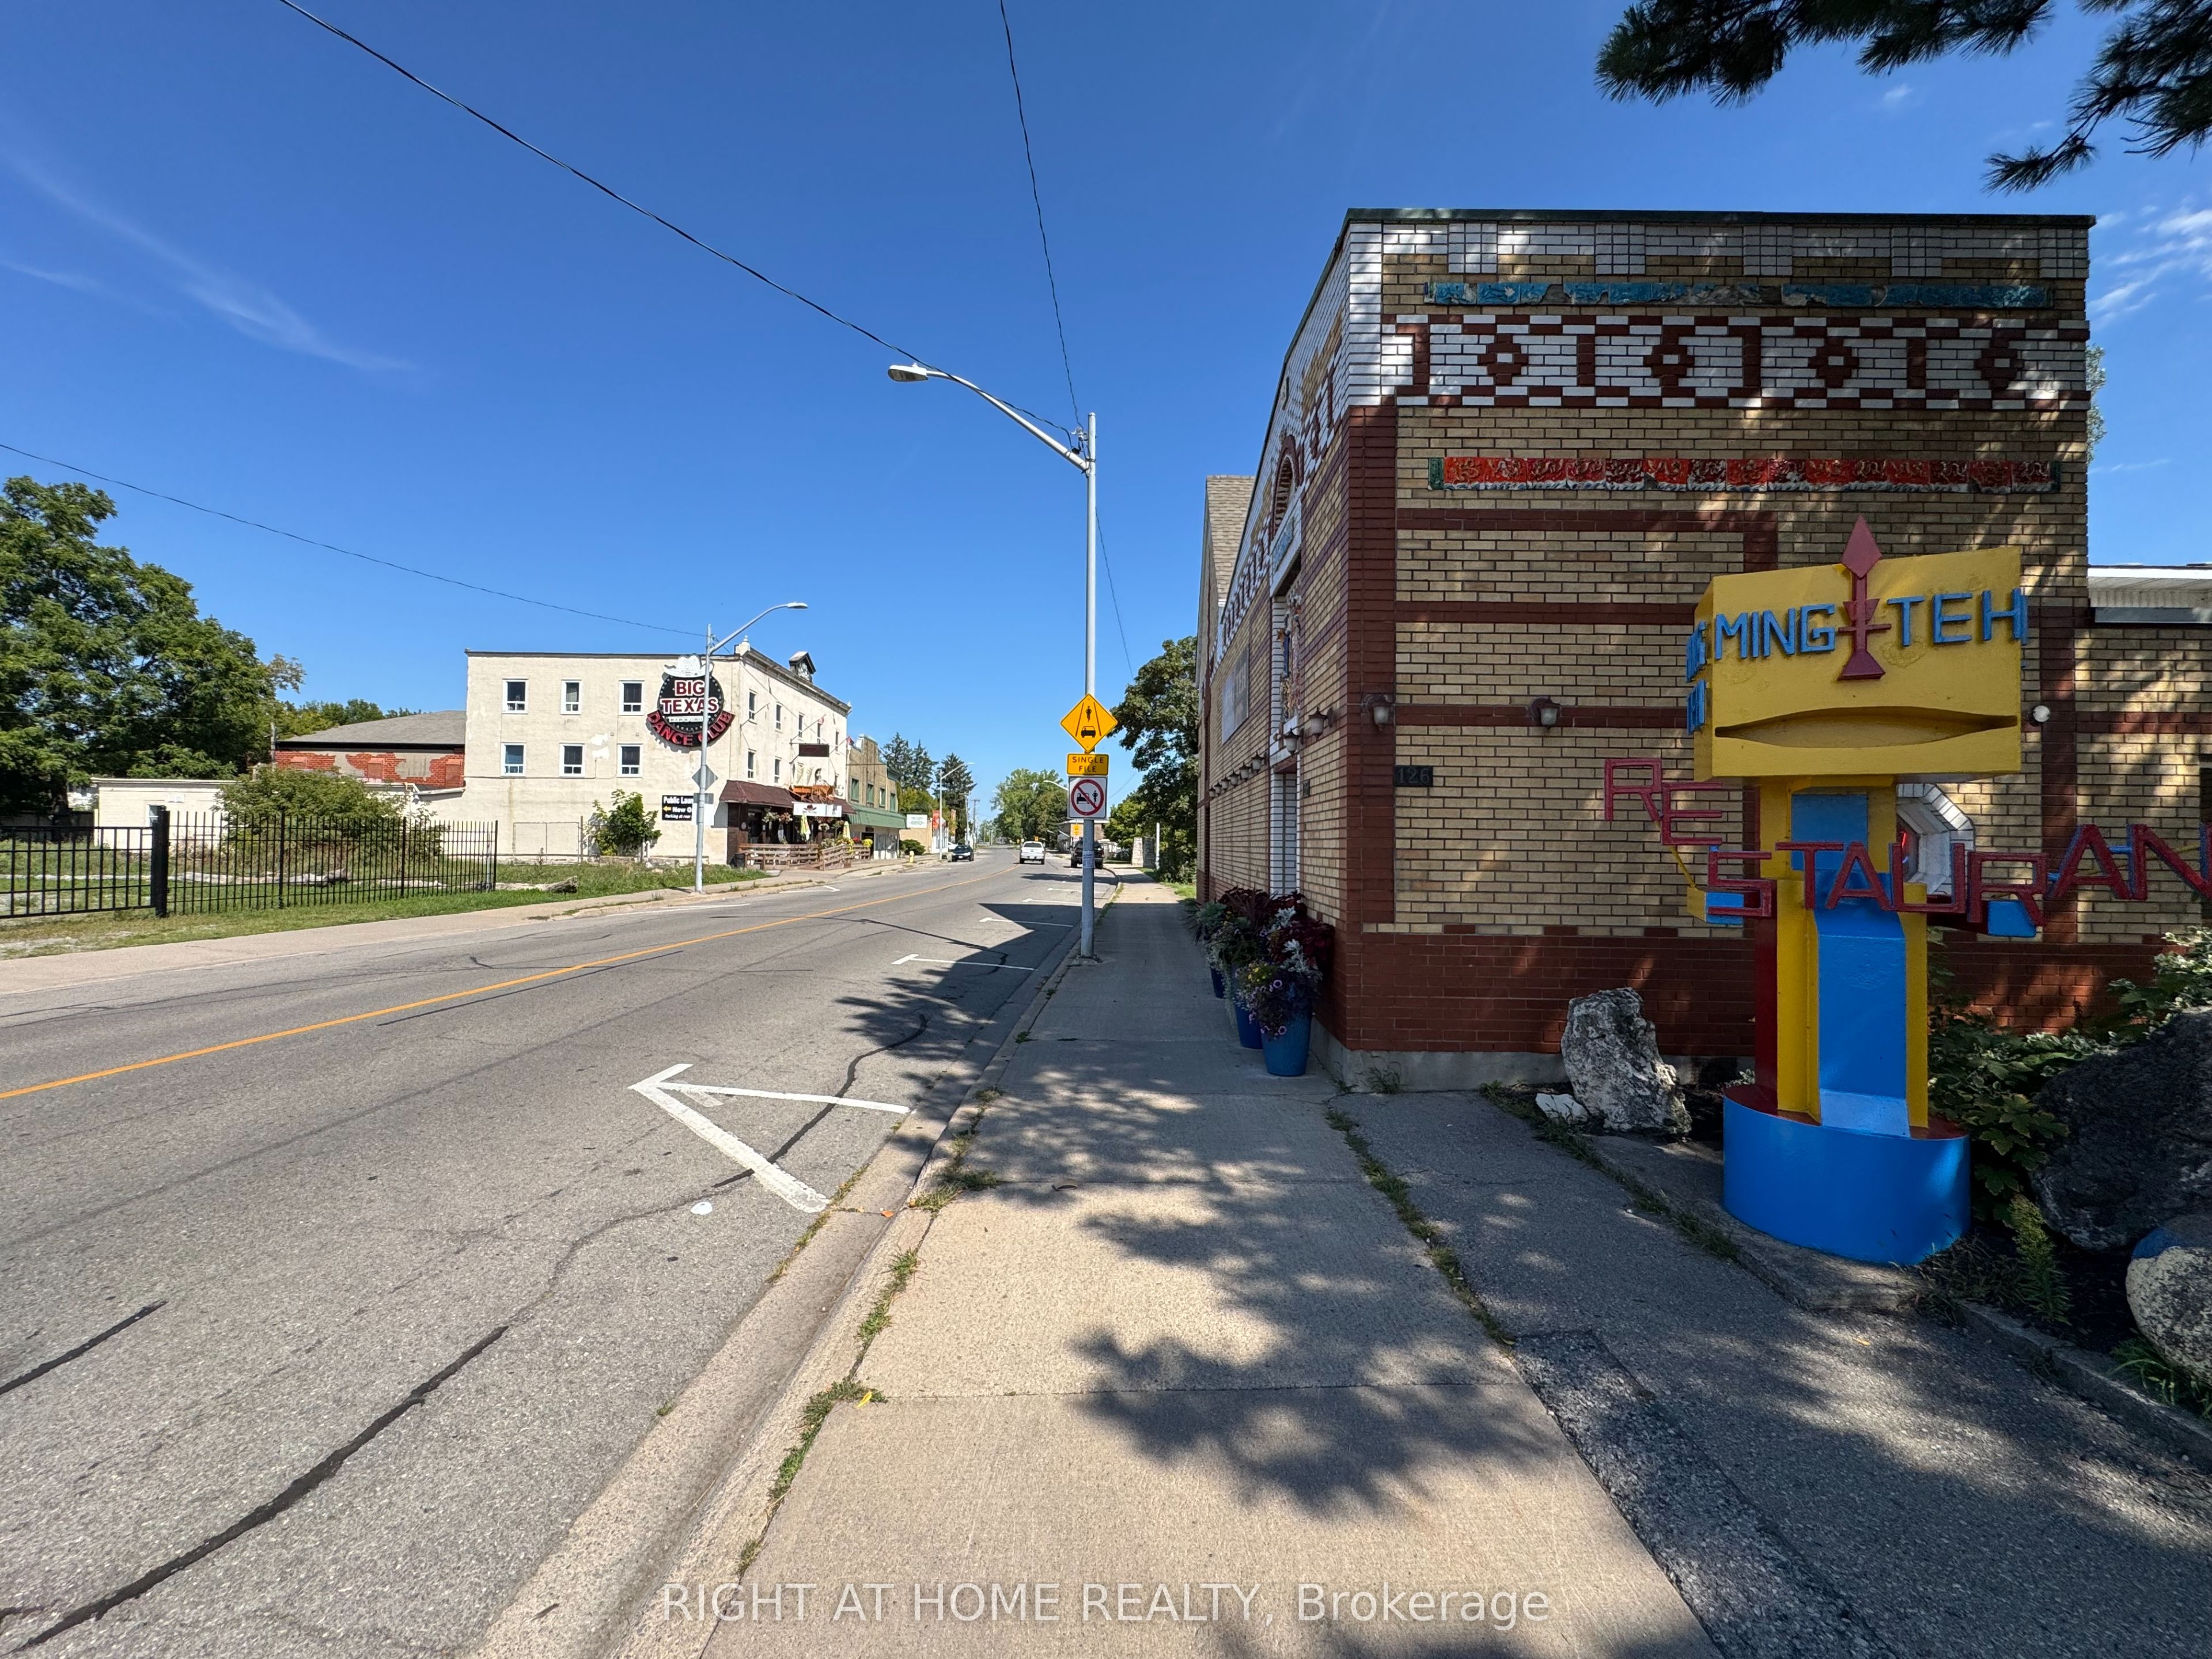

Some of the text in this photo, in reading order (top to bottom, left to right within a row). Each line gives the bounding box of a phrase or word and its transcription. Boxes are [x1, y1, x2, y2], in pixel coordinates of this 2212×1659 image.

[1715, 603, 1835, 661] MING
[1887, 588, 2021, 647] TEH
[675, 680, 705, 696] BIG
[660, 697, 719, 714] TEXAS
[647, 711, 693, 745] DANCE
[1397, 767, 1429, 783] 126
[664, 796, 680, 804] Public
